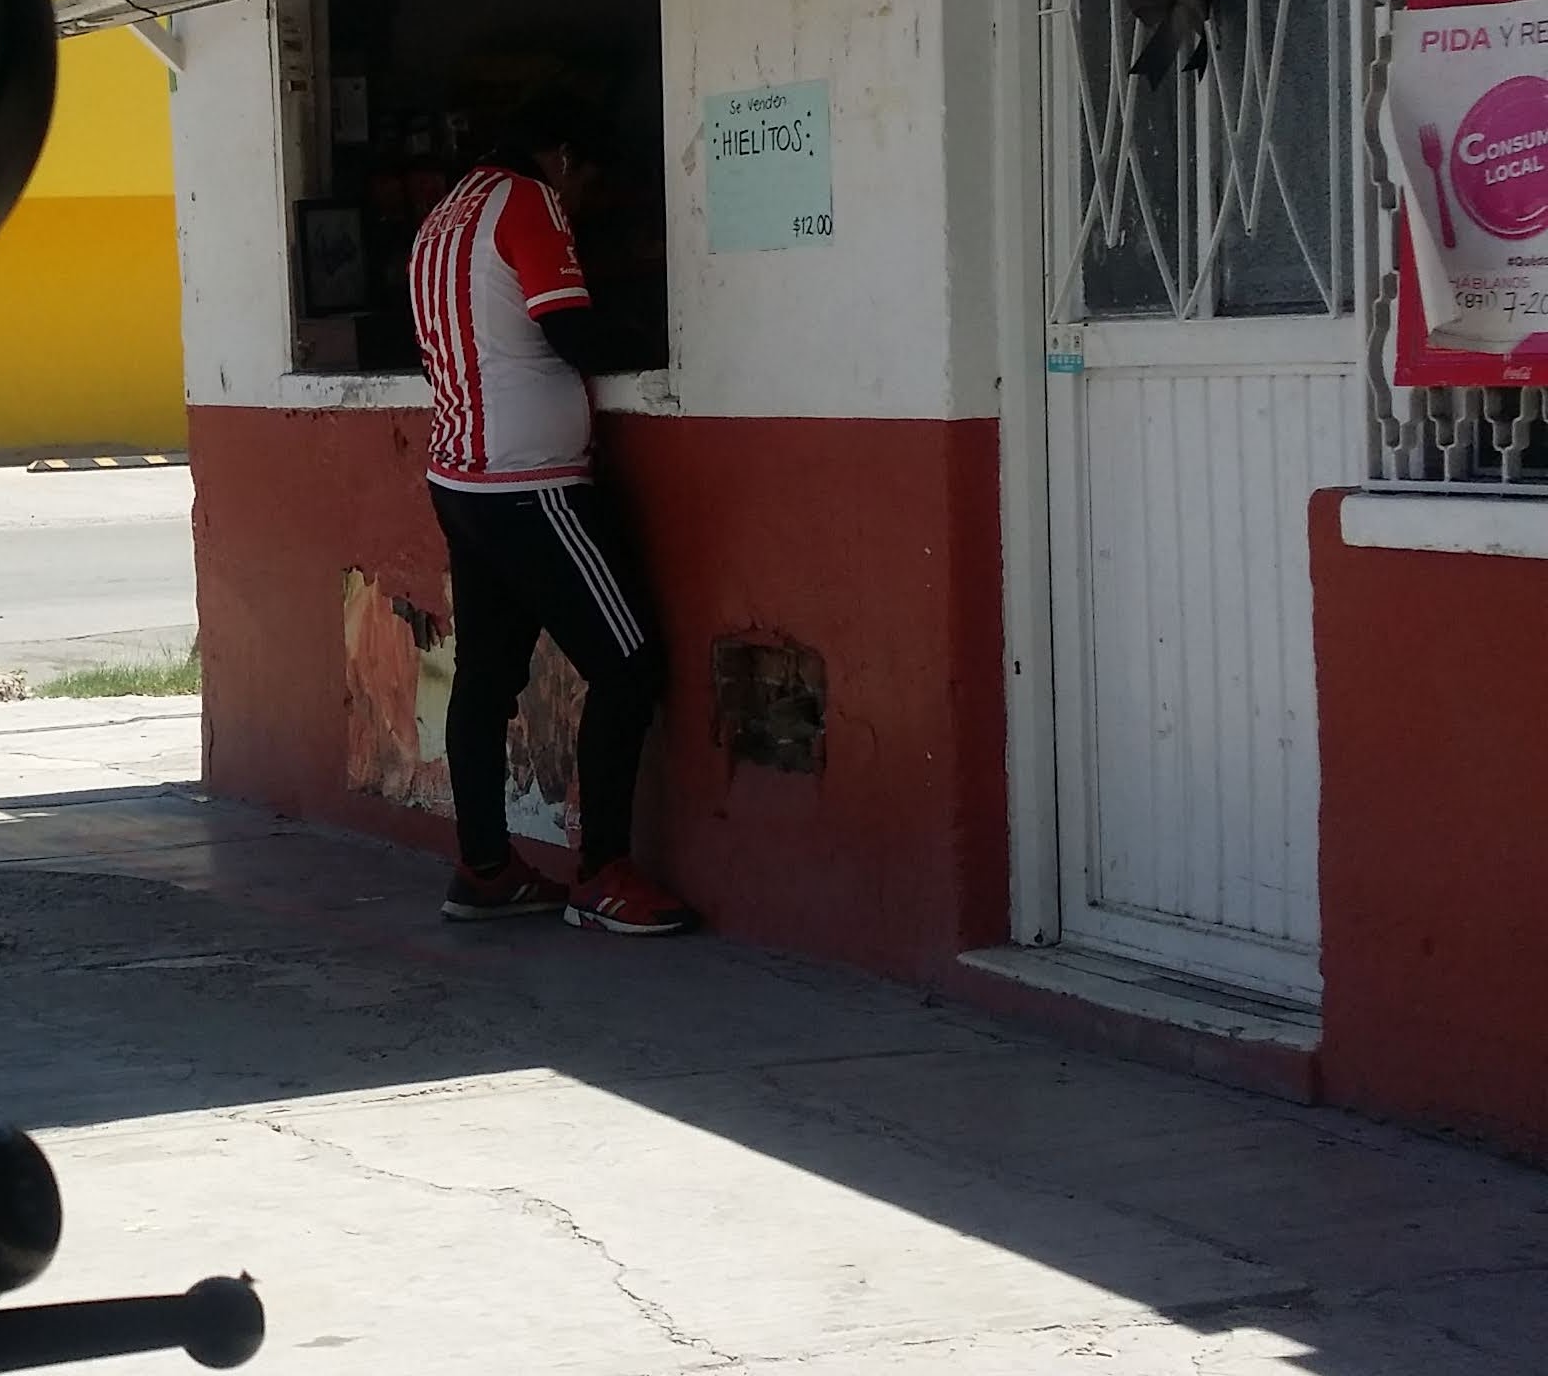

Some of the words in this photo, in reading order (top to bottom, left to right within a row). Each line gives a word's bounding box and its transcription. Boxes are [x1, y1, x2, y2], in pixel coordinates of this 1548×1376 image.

[1420, 27, 1492, 53] PIDA
[1499, 22, 1515, 48] Y
[1521, 21, 1548, 46] RE
[729, 99, 742, 115] Se
[1484, 155, 1545, 186] LOCAL
